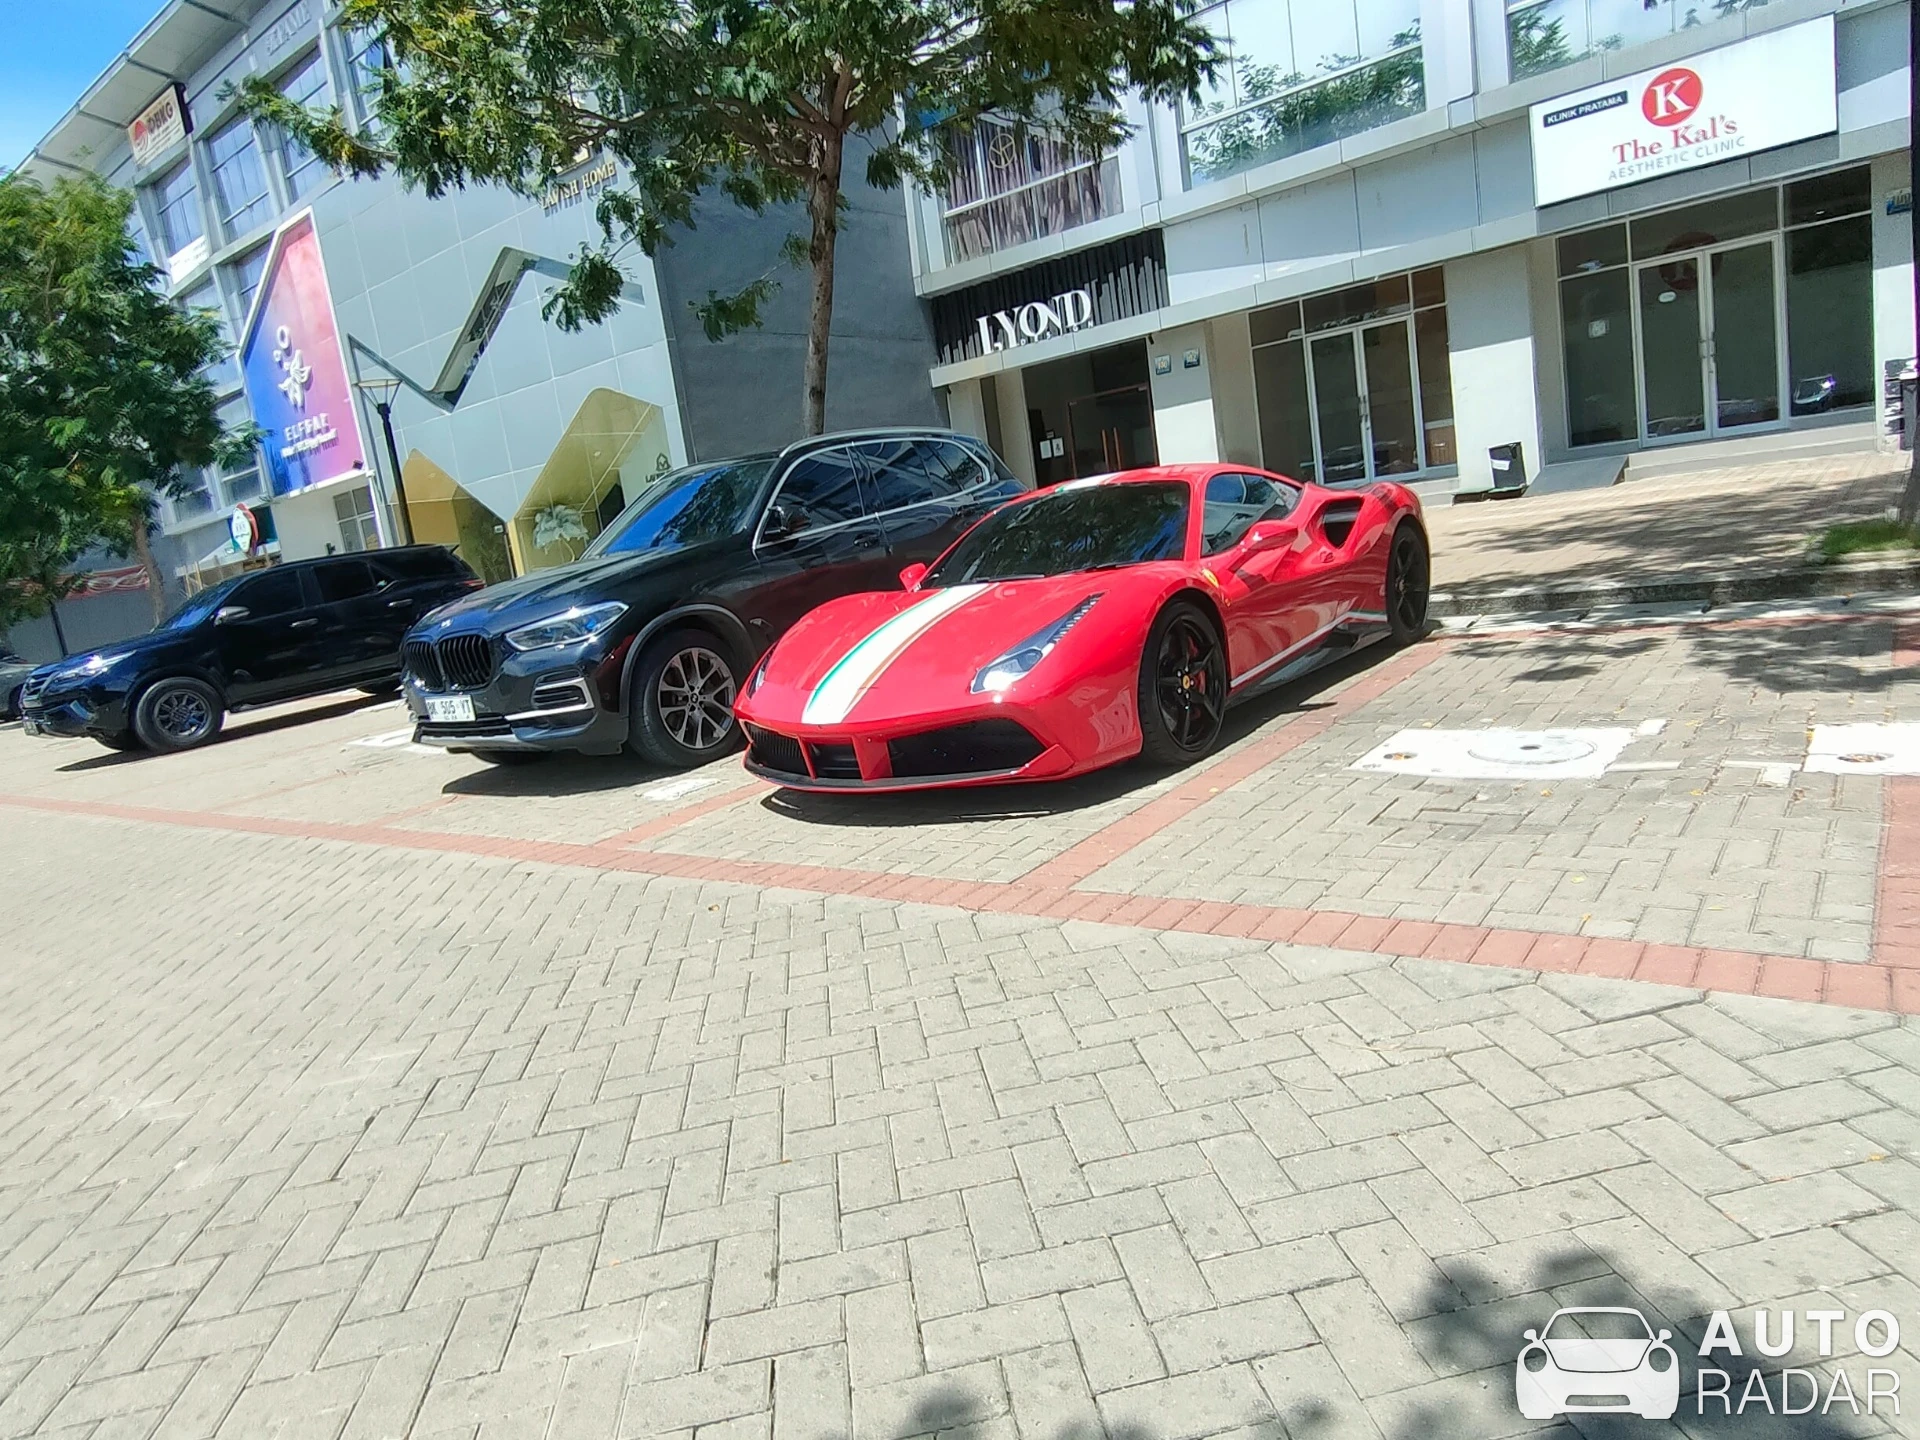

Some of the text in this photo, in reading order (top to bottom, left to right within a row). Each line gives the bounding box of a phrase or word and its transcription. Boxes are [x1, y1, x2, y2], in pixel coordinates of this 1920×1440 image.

[1547, 95, 1624, 124] KLINIK PRATAMA
[1651, 75, 1693, 120] K
[1608, 136, 1745, 180] AESTHETIC CLINIC
[1613, 114, 1738, 164] The Kal's
[582, 161, 615, 190] HOME
[976, 289, 1091, 355] LYOND
